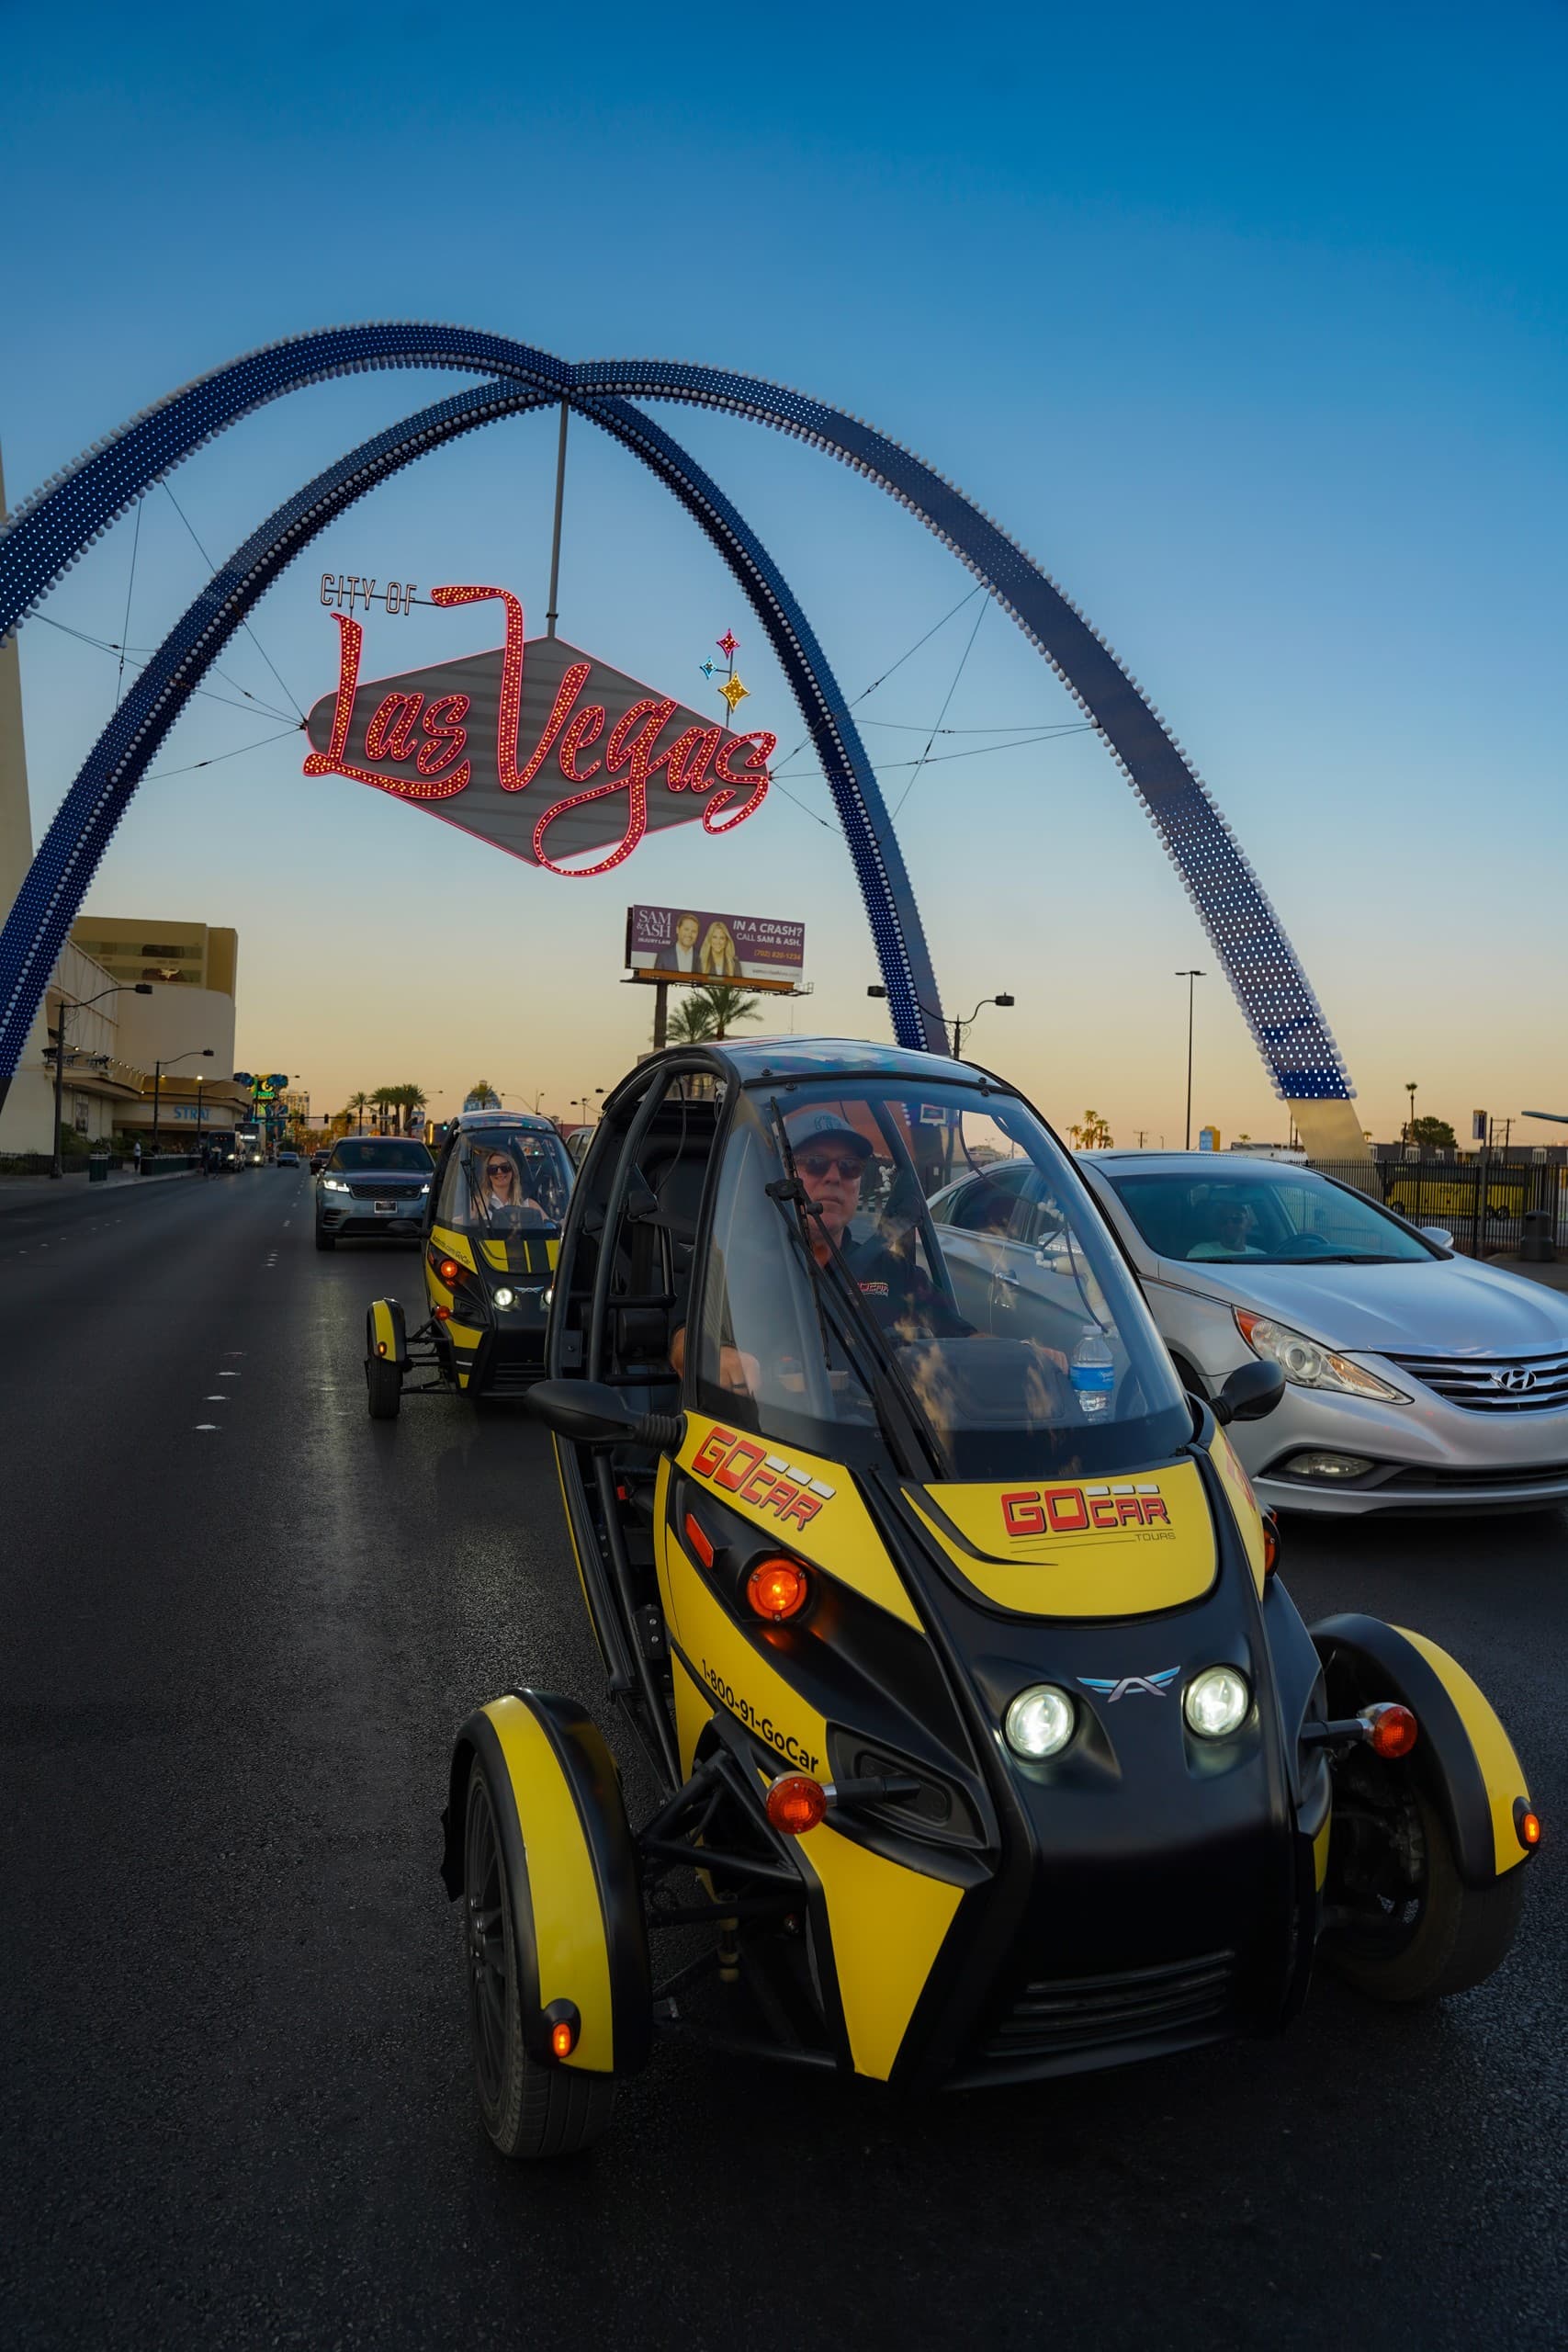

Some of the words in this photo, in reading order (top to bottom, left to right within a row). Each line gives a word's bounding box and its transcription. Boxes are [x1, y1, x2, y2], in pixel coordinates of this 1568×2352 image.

[321, 573, 376, 610] CITY
[387, 582, 417, 616] OF
[302, 612, 471, 800] Las
[430, 585, 778, 877] Vegas
[639, 910, 671, 925] SAM
[640, 923, 671, 938] ASH
[733, 921, 746, 931] IN
[749, 922, 756, 932] A
[760, 923, 802, 936] CRASH?
[737, 933, 755, 942] CALL
[757, 935, 774, 944] SAM
[784, 938, 801, 946] ASH.
[1134, 1532, 1177, 1542] TOURS
[702, 1658, 819, 1774] 1-800-91-GoCar
